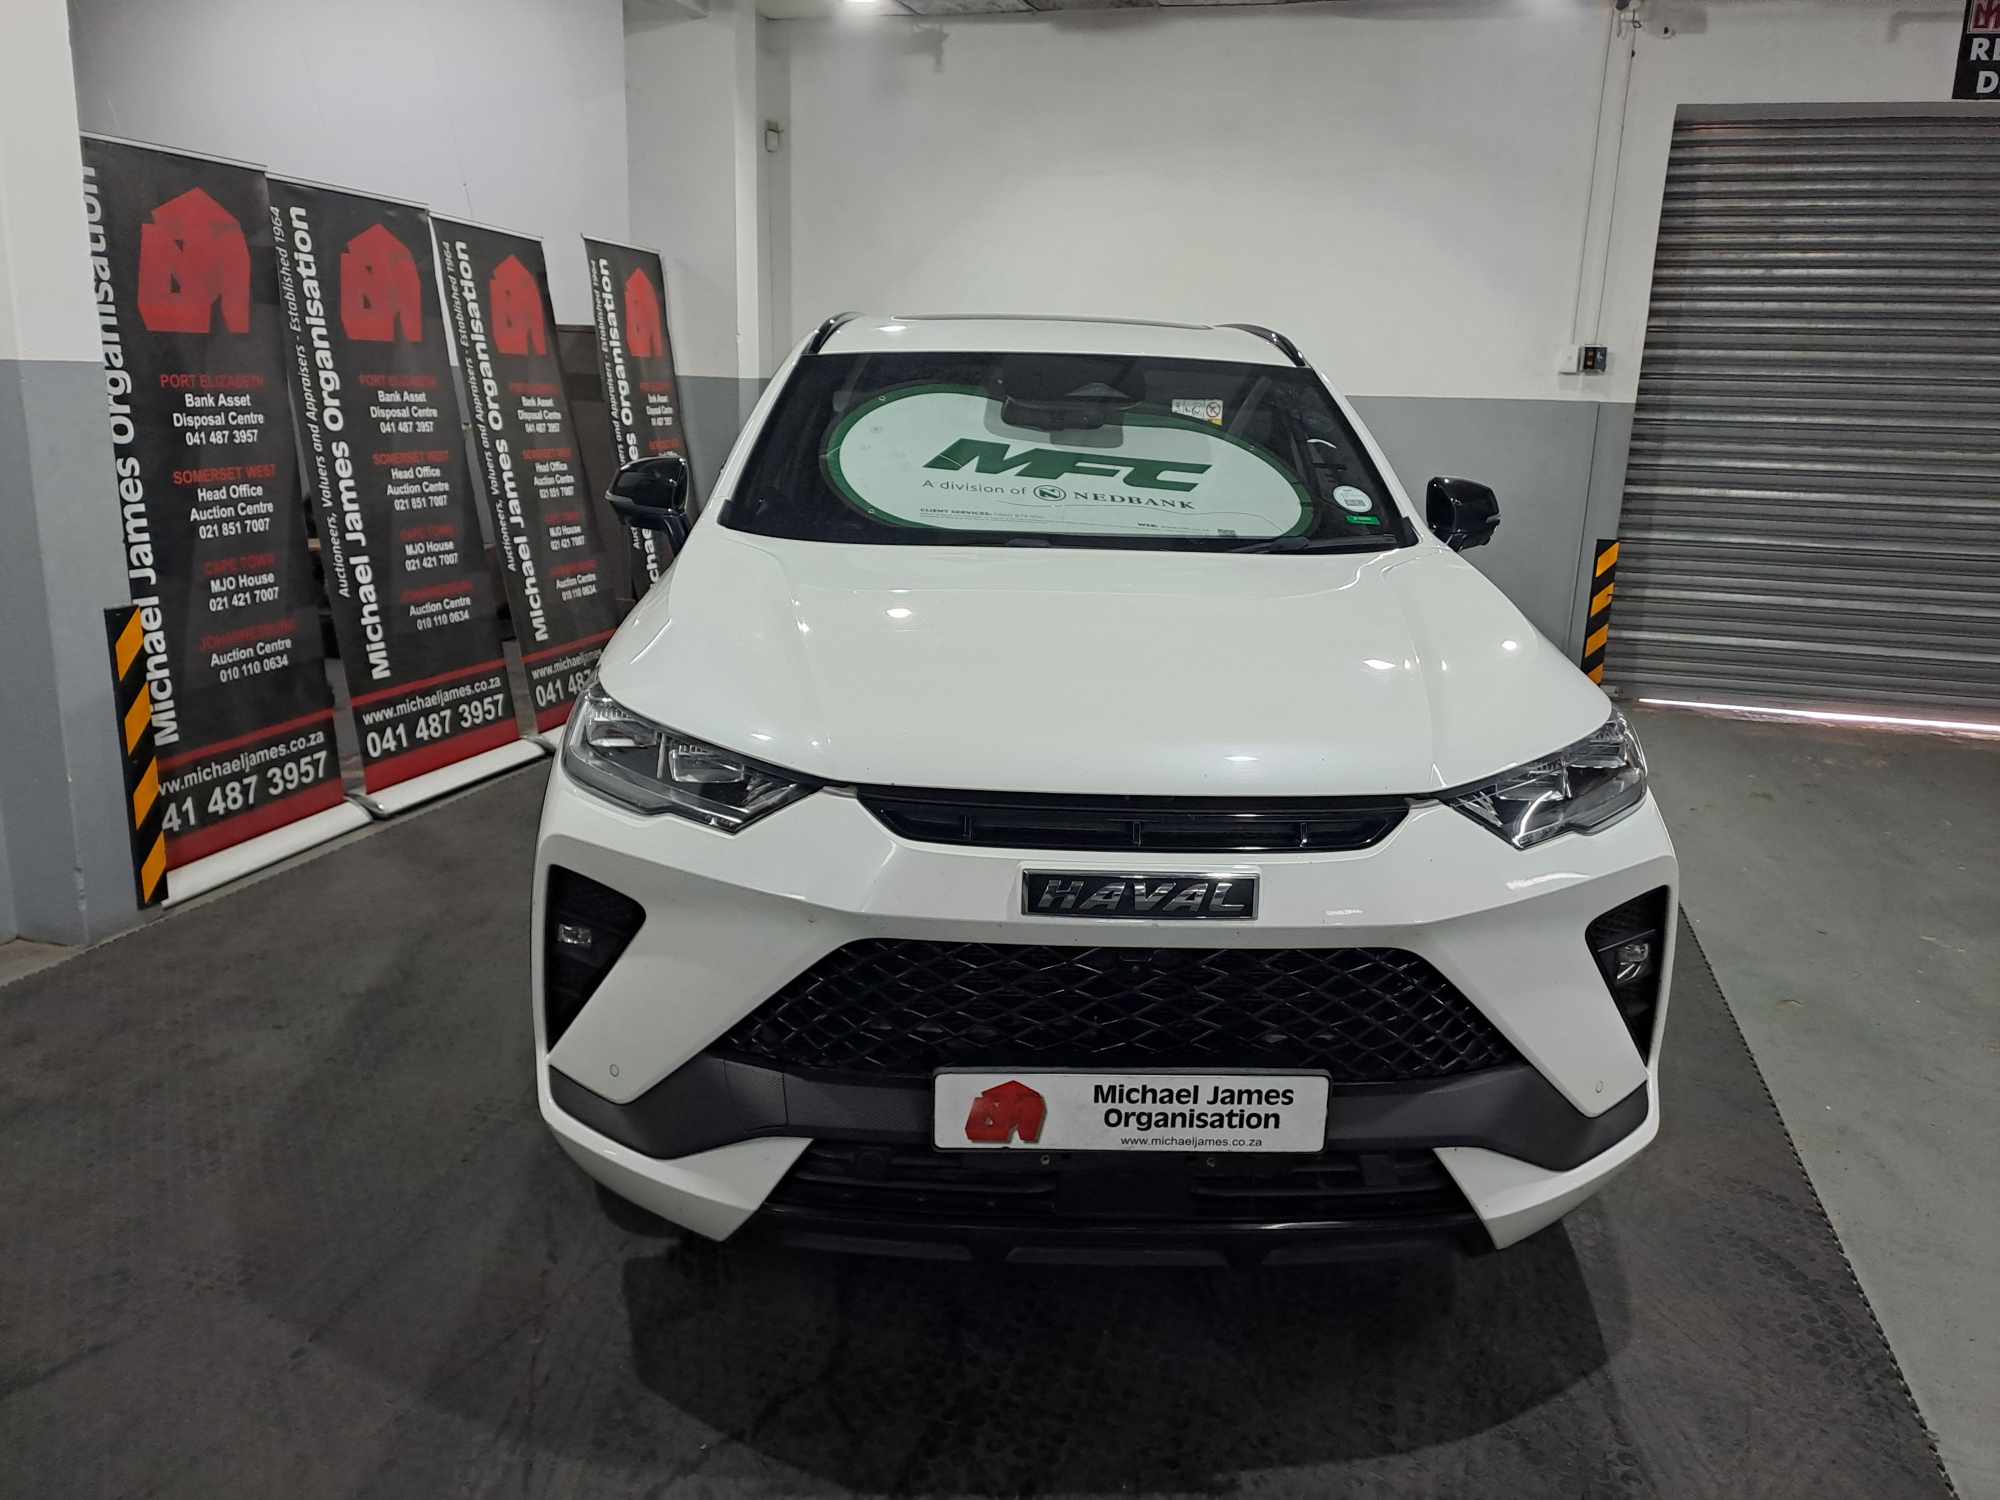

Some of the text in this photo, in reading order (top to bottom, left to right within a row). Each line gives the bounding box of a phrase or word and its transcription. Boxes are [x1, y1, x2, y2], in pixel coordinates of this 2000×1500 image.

[1970, 37, 2000, 61] R
[1976, 70, 2000, 94] D
[275, 246, 302, 332] Established
[598, 258, 633, 426] Organisation
[296, 344, 319, 421] Appraisers
[184, 393, 252, 407] Bank Asset
[369, 406, 410, 420] Disposal
[172, 411, 265, 429] Disposal Centre
[185, 429, 259, 446] 041 487 3957
[290, 206, 391, 680] Michael James Organisation
[307, 422, 323, 452] and
[455, 241, 549, 642] Michael James Organisation
[922, 438, 1213, 492] MFC
[197, 484, 264, 501] Head Office
[315, 455, 333, 508] Valuers
[387, 484, 421, 495] Auction
[920, 479, 1196, 510] A division of NEDBANK
[117, 456, 156, 584] James
[190, 501, 274, 521] Auction Centre
[199, 517, 271, 540] 021 851 7007
[327, 512, 350, 598] Auctioneers,
[426, 541, 454, 552] House
[210, 572, 275, 593] MJO House
[209, 587, 280, 612] 021 421 7007
[409, 601, 442, 616] Auction
[210, 639, 292, 667] Auction Centre
[132, 596, 179, 746] Michael
[220, 654, 289, 682] 010 110 0634
[362, 676, 501, 726] www.michaeljames.co.za
[535, 679, 564, 707] 041
[366, 693, 505, 758] 041 487 3957
[158, 731, 325, 796] ww.michaeljames.co.za
[161, 750, 329, 831] 41 487 3957
[1039, 879, 1245, 912] HAVAL
[1093, 1084, 1295, 1107] Michael James
[1103, 1108, 1281, 1132] Organisation
[1119, 1135, 1263, 1149] www.michaeljames.co.za
